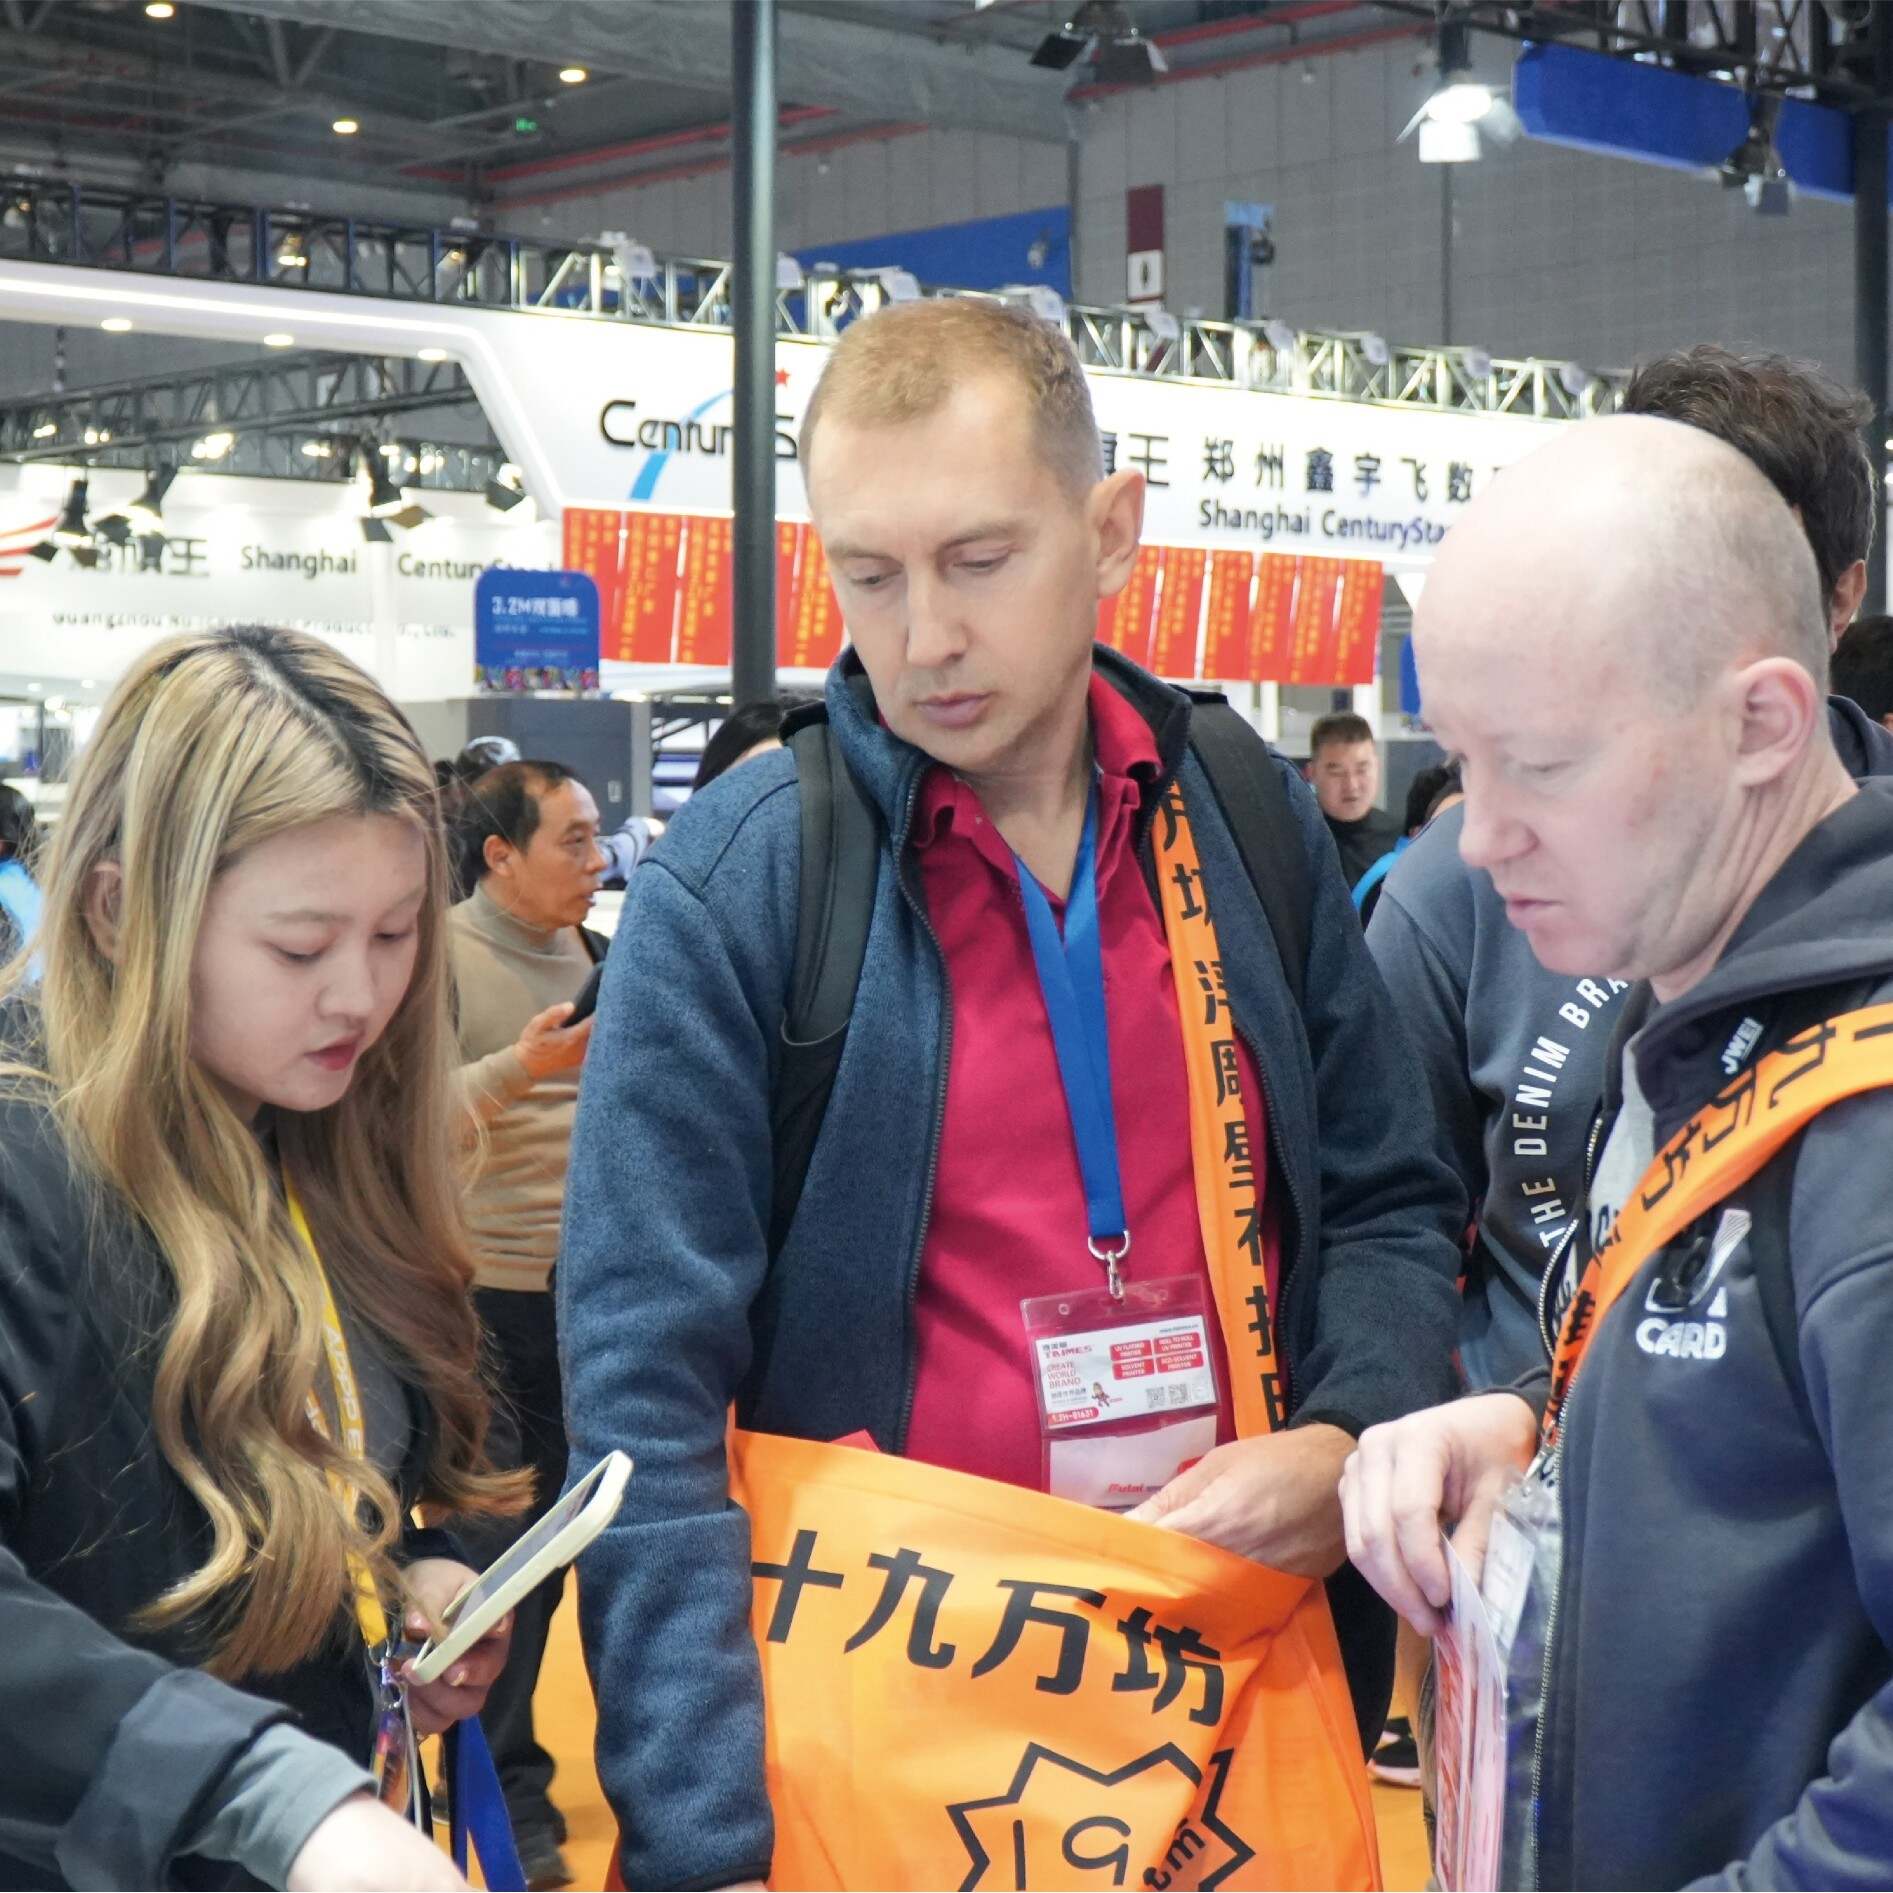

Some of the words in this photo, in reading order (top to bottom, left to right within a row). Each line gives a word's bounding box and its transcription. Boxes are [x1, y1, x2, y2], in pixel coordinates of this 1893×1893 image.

[1200, 500, 1310, 540] Shanghai
[1322, 510, 1453, 550] CenturySta
[241, 545, 357, 580] Shanghai
[1512, 1036, 1570, 1156] DENIM
[1520, 1177, 1567, 1248] THE
[1635, 1317, 1728, 1360] CARD
[1049, 1377, 1081, 1390] BRAND
[752, 1528, 1225, 1727] 十九万坊
